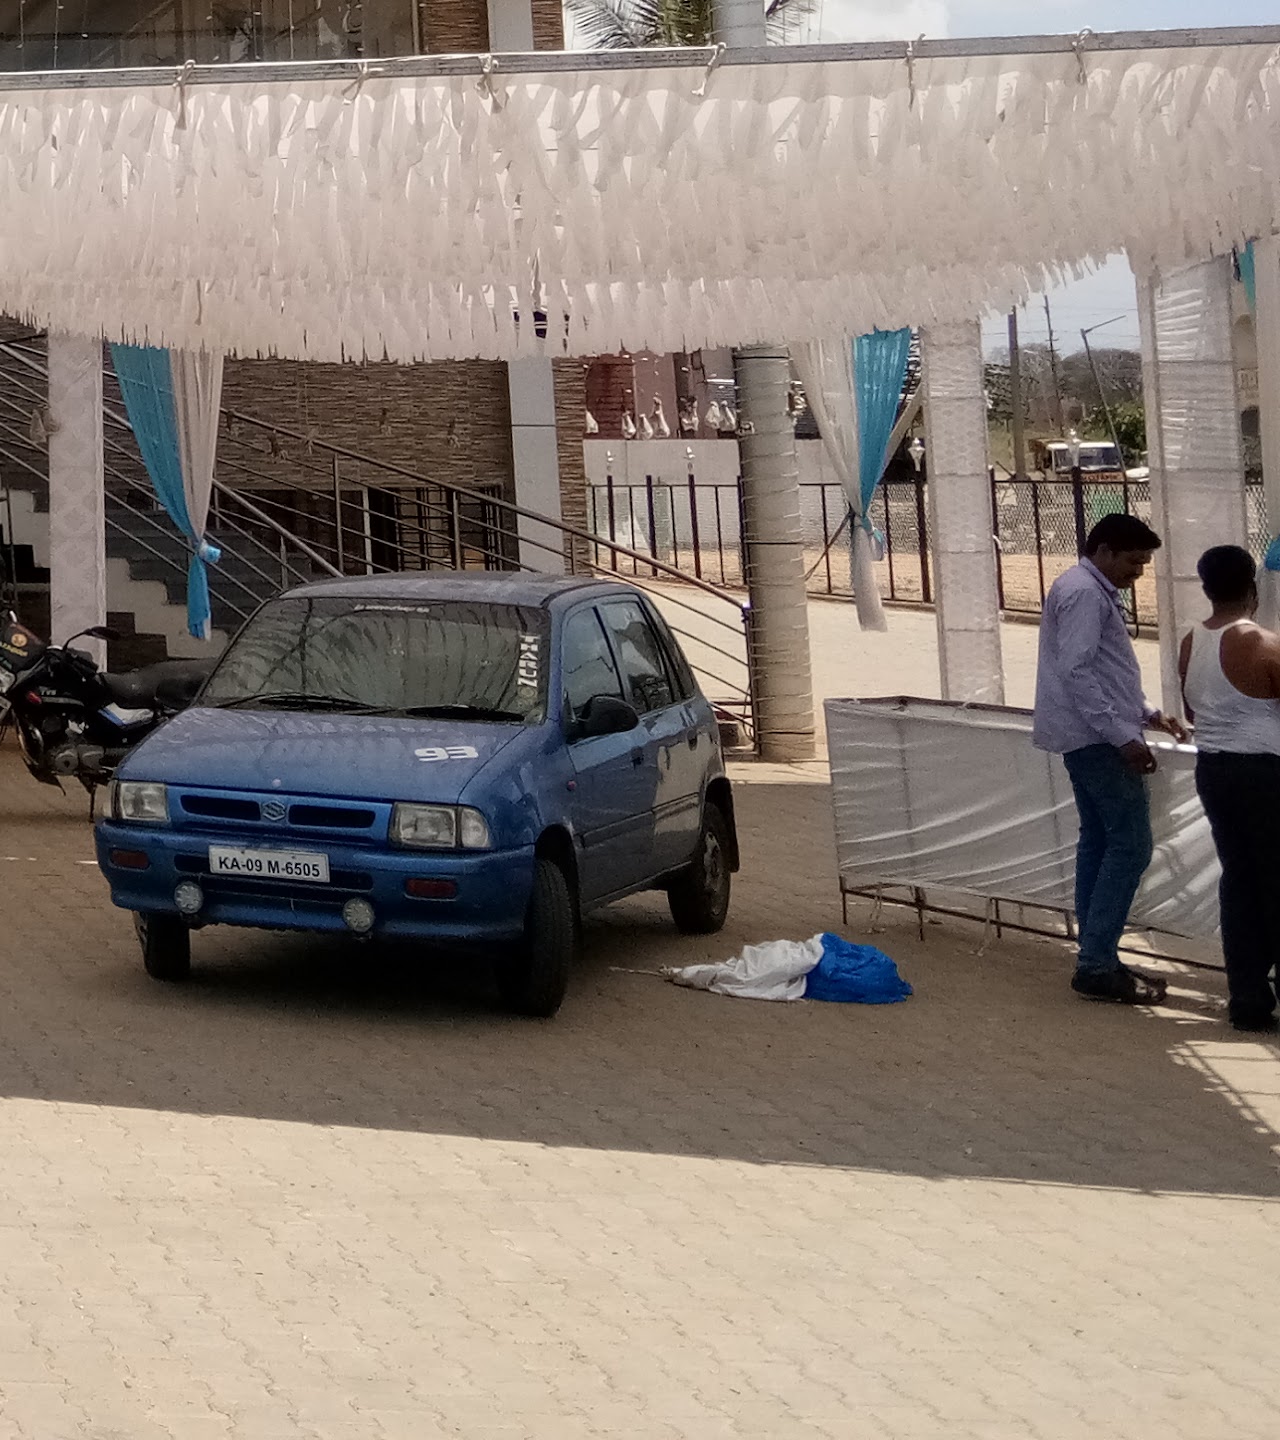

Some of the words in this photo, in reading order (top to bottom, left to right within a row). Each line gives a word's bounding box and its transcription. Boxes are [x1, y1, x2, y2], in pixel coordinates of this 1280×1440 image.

[414, 746, 479, 762] 93
[218, 856, 263, 873] KA-09
[267, 860, 321, 878] M-6505
